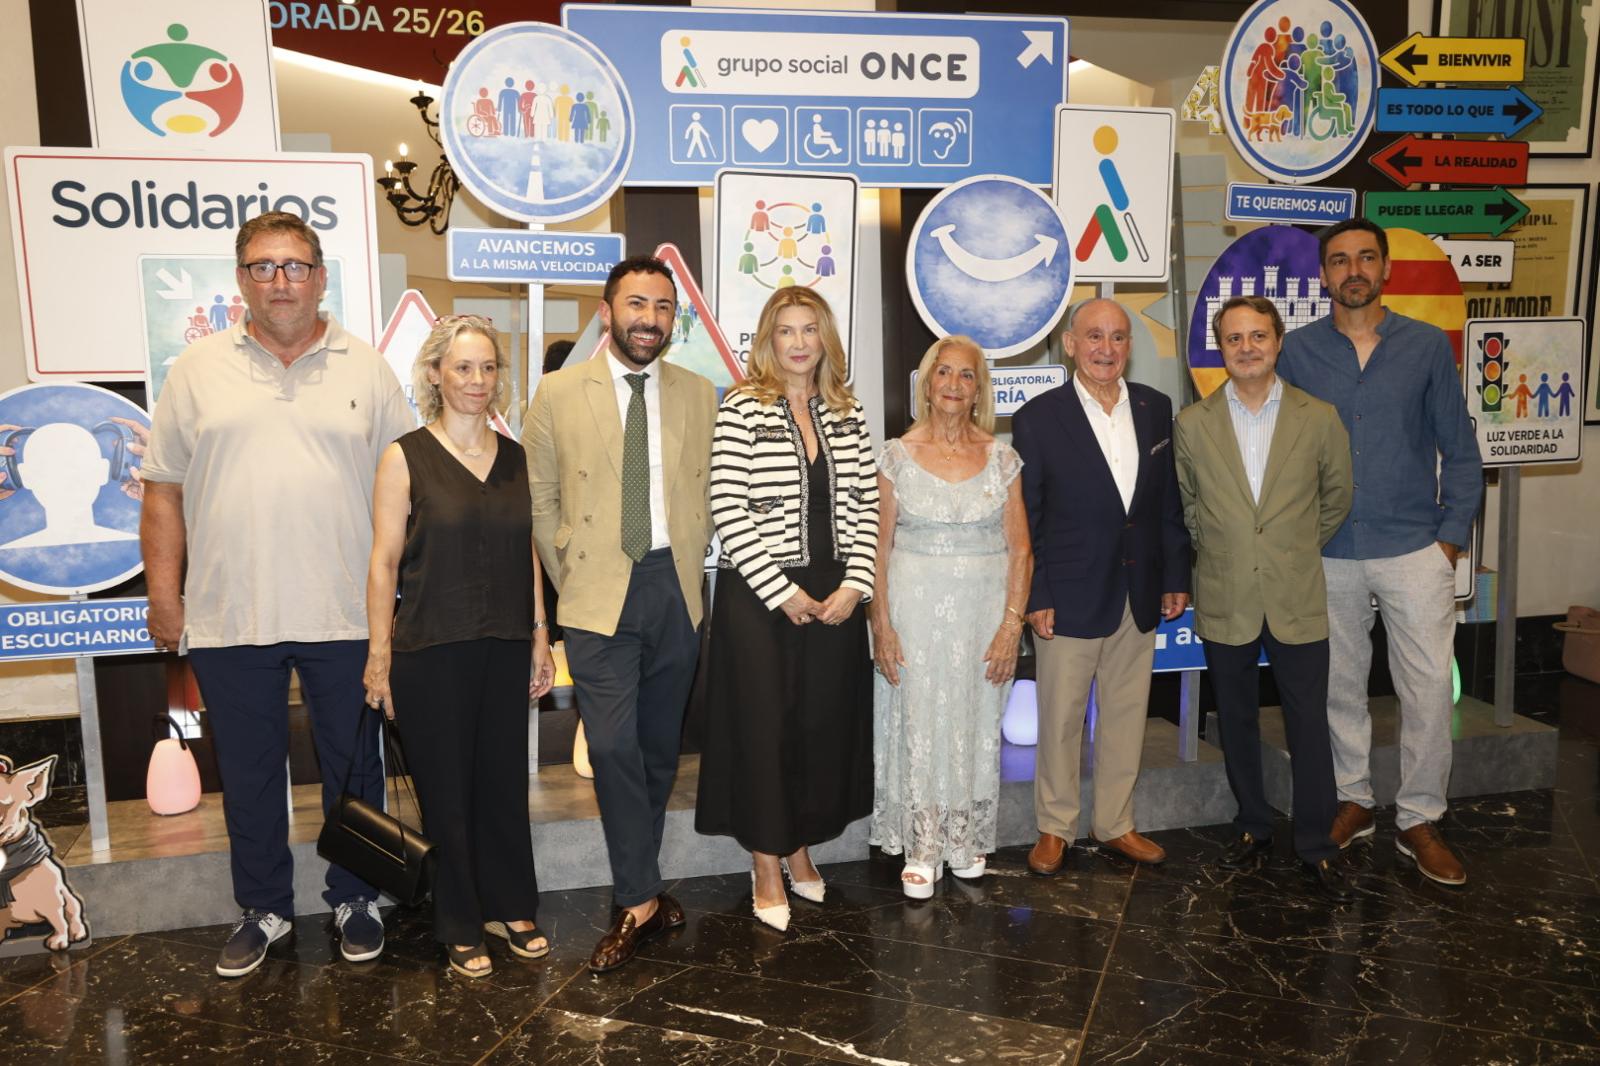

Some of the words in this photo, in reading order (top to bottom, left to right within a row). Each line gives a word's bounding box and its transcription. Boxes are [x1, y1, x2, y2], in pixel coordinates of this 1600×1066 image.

[392, 7, 485, 38] 25/26
[717, 56, 782, 77] grupo
[788, 55, 848, 74] social
[860, 52, 968, 81] ONCE
[1438, 53, 1512, 67] BIENVIVIR
[1387, 104, 1403, 115] ES
[1406, 104, 1443, 115] TODO
[1447, 105, 1464, 115] LO
[1468, 105, 1494, 118] QUE
[1434, 156, 1449, 167] LA
[1454, 157, 1517, 168] REALIDAD
[51, 179, 338, 231] Solidarios
[1236, 195, 1250, 208] TE
[1252, 196, 1317, 212] QUEREMOS
[1318, 198, 1347, 215] AQUÍ
[1378, 205, 1422, 216] PUEDE
[1425, 204, 1474, 216] LLEGAR
[477, 238, 595, 257] AVANCEMOS
[460, 258, 470, 269] A
[473, 258, 490, 270] LA
[493, 259, 538, 271] MISMA
[541, 260, 614, 273] VELOCIDAD
[1461, 254, 1472, 267] A
[1475, 255, 1502, 267] SER
[1486, 431, 1506, 442] LUZ
[1508, 430, 1541, 441] VERDE
[1542, 429, 1550, 440] A
[1552, 428, 1564, 439] LA
[1490, 443, 1558, 457] SOLIDARIDAD
